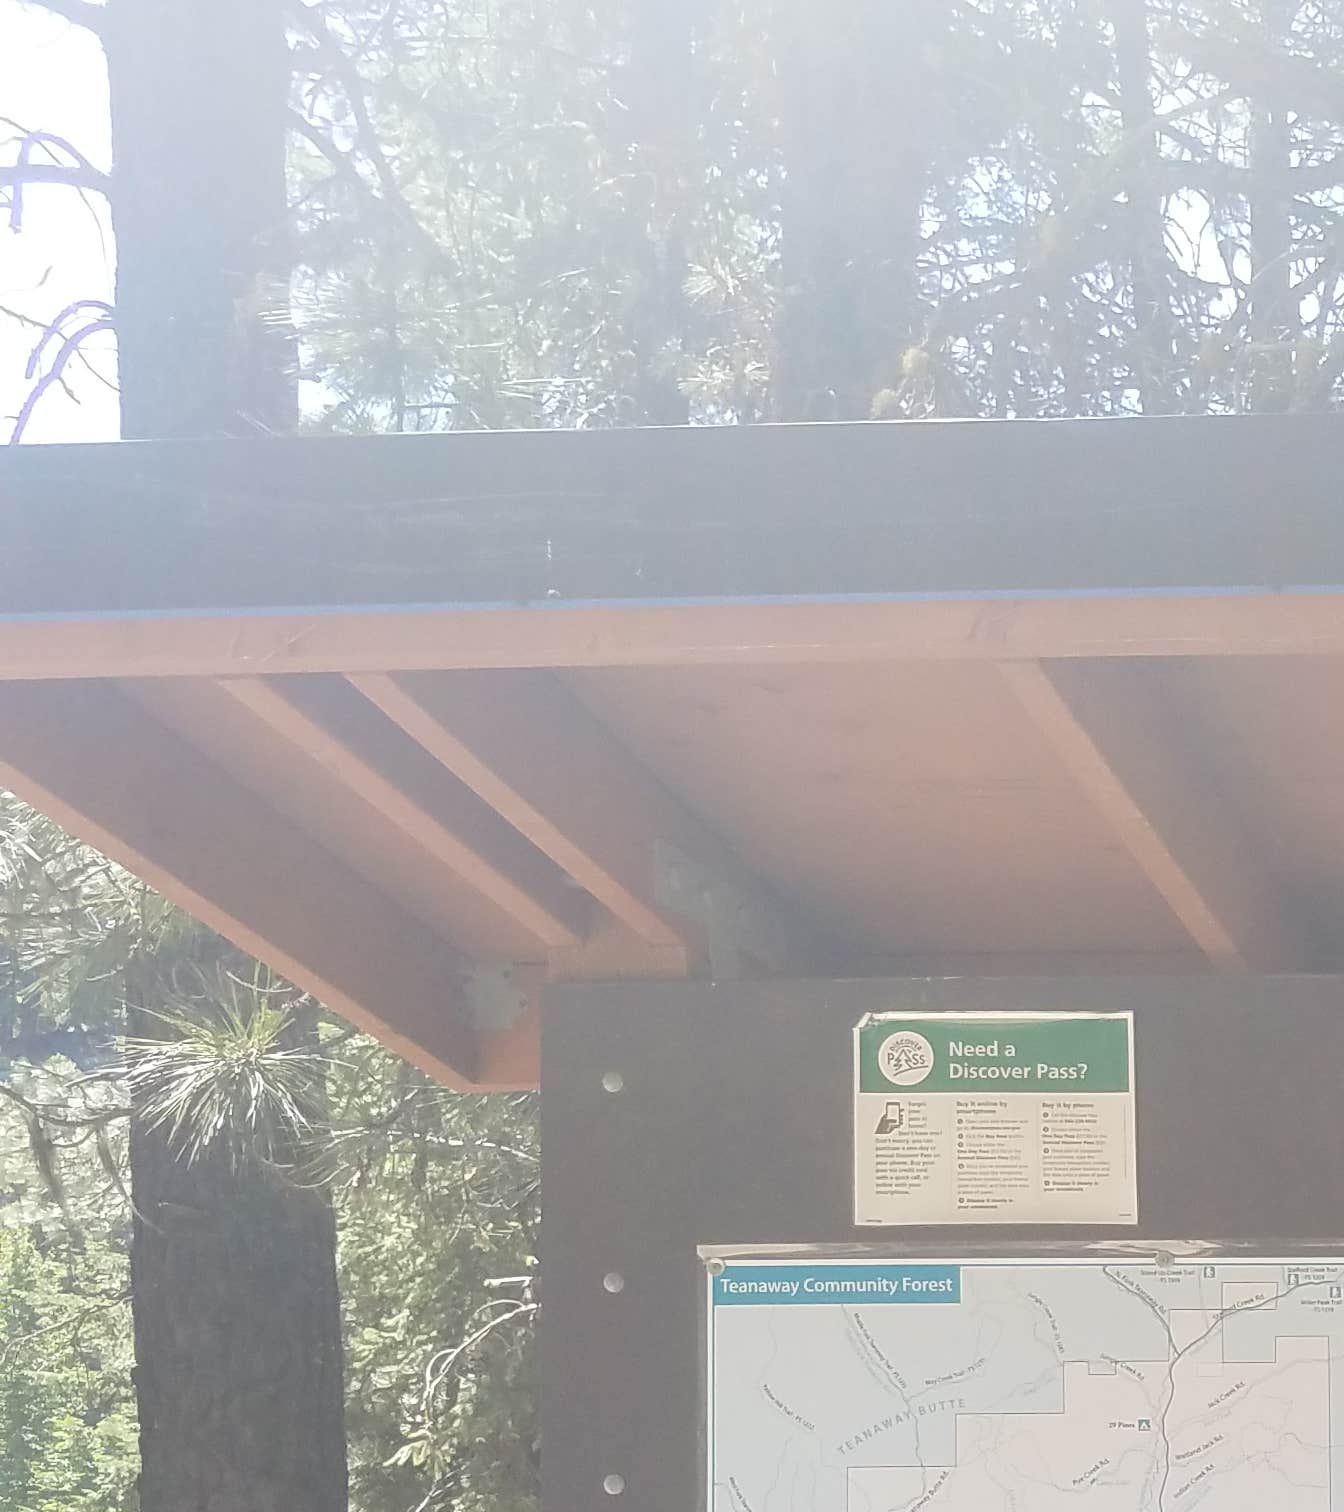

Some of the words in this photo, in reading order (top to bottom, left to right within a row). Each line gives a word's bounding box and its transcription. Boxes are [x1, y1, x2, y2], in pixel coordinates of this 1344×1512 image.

[950, 1041, 998, 1056] Need
[1005, 1045, 1015, 1056] a
[950, 1063, 1030, 1079] Discover
[1037, 1064, 1087, 1079] Pass?
[721, 1279, 799, 1296] Teanaway
[804, 1277, 898, 1294] Community
[902, 1277, 952, 1293] Forest
